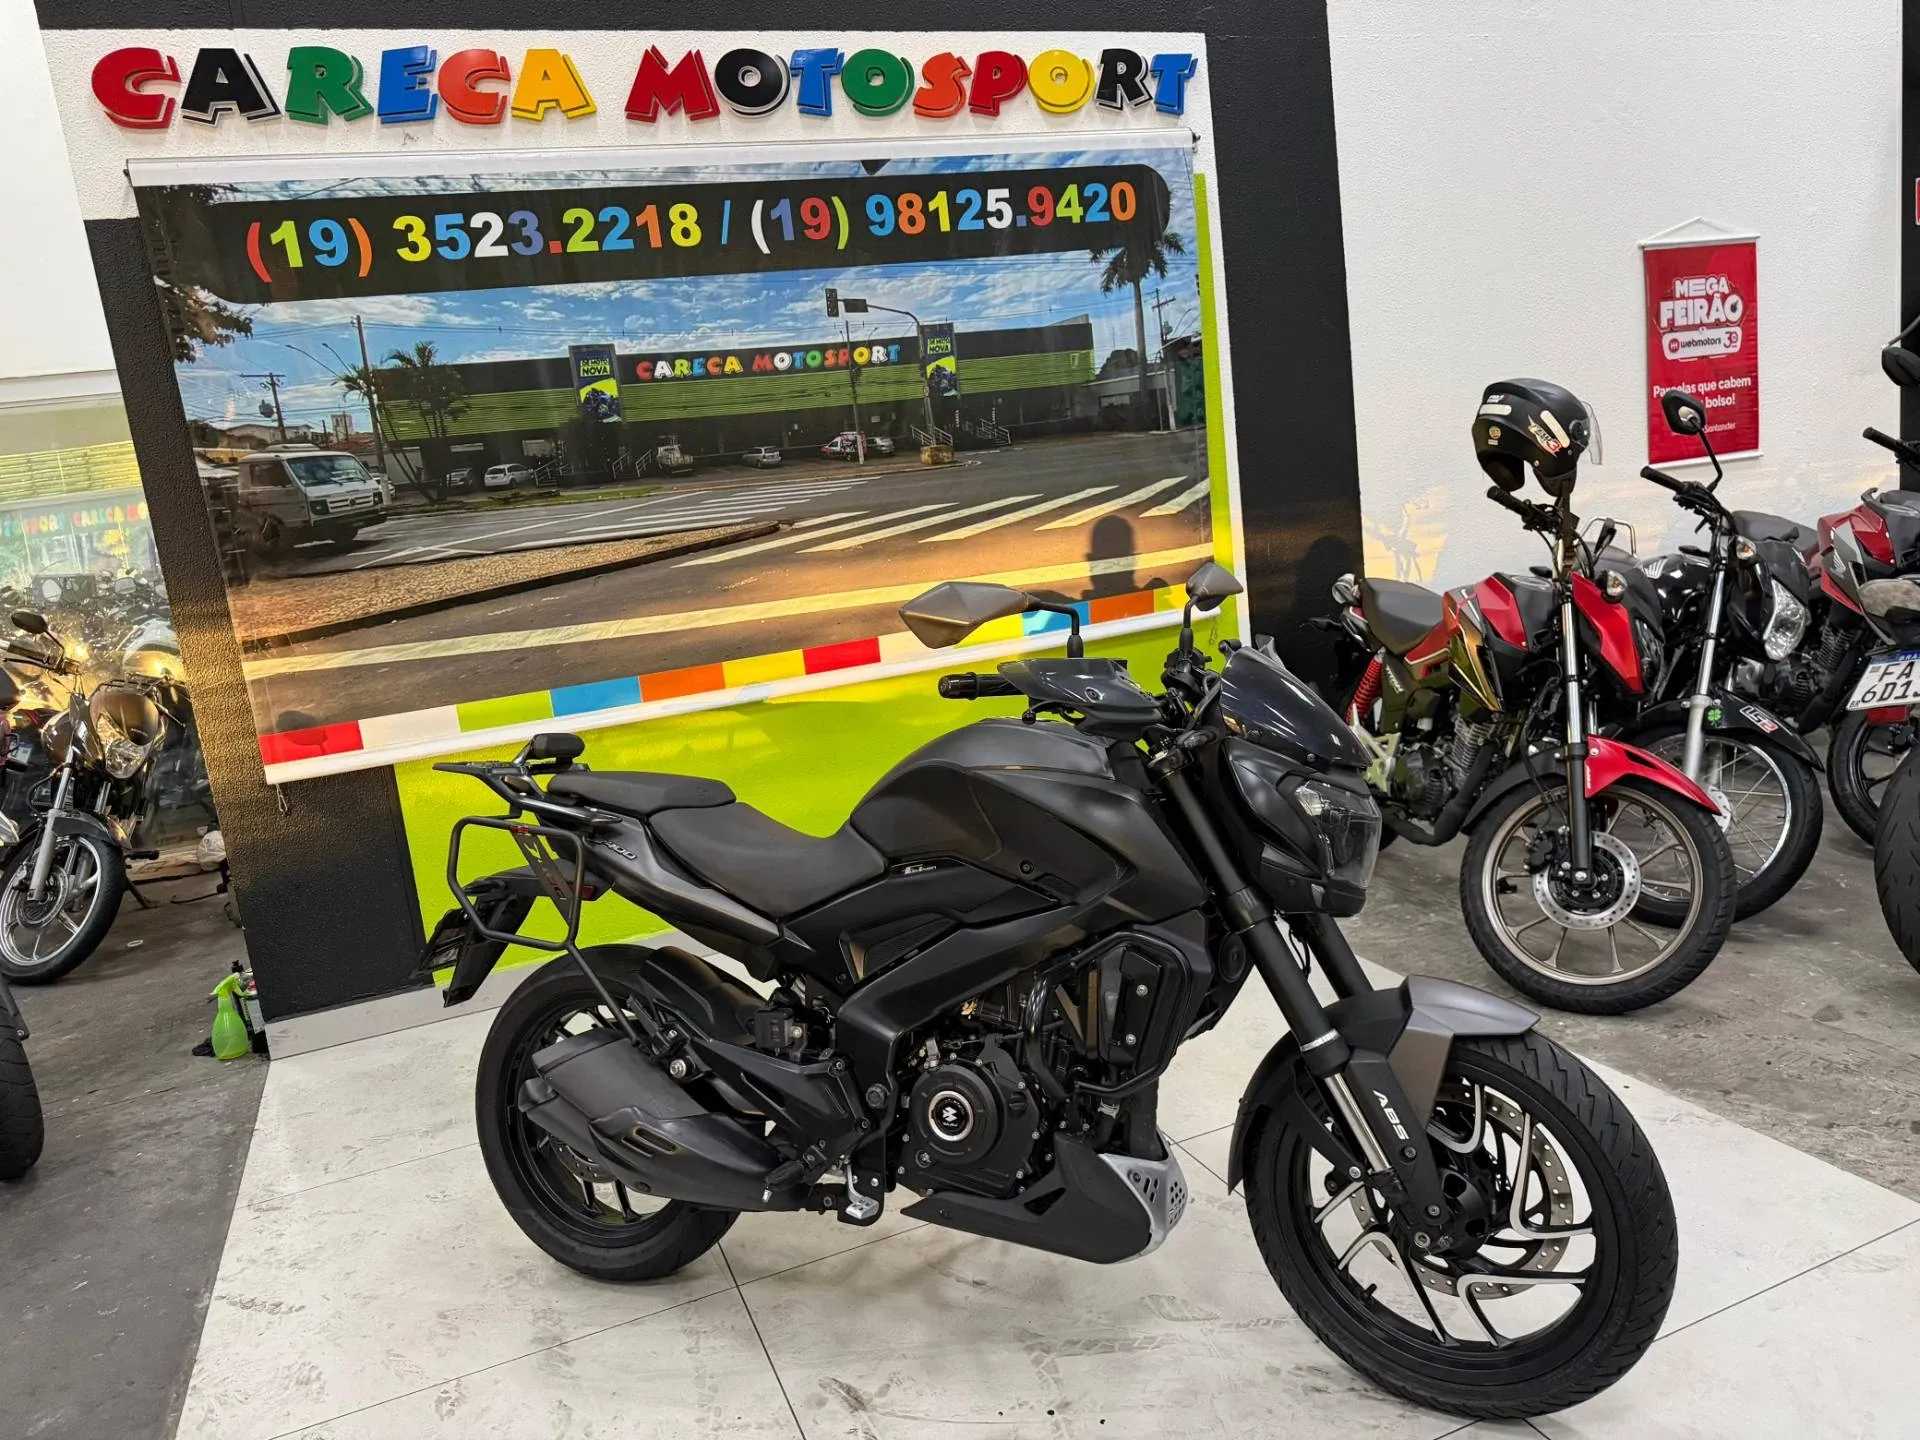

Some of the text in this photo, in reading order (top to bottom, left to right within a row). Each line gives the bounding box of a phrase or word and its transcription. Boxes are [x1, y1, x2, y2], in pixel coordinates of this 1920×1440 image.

[91, 44, 1197, 129] CARECA MOTOSPORT
[246, 216, 373, 284] (19)
[392, 203, 702, 262] 3523.2218
[751, 196, 849, 255] (19)
[866, 181, 1137, 238] 98125.9420
[1674, 276, 1730, 298] MEGA
[1659, 292, 1743, 328] FEIRÃO
[1680, 336, 1721, 349] webmotors
[581, 366, 609, 375] NOVA
[635, 343, 901, 381] CARECA MOTOSPORT
[1697, 381, 1717, 395] que
[1718, 376, 1752, 390] cabem
[1705, 393, 1736, 408] bolso!
[1372, 1088, 1410, 1140] ABS
